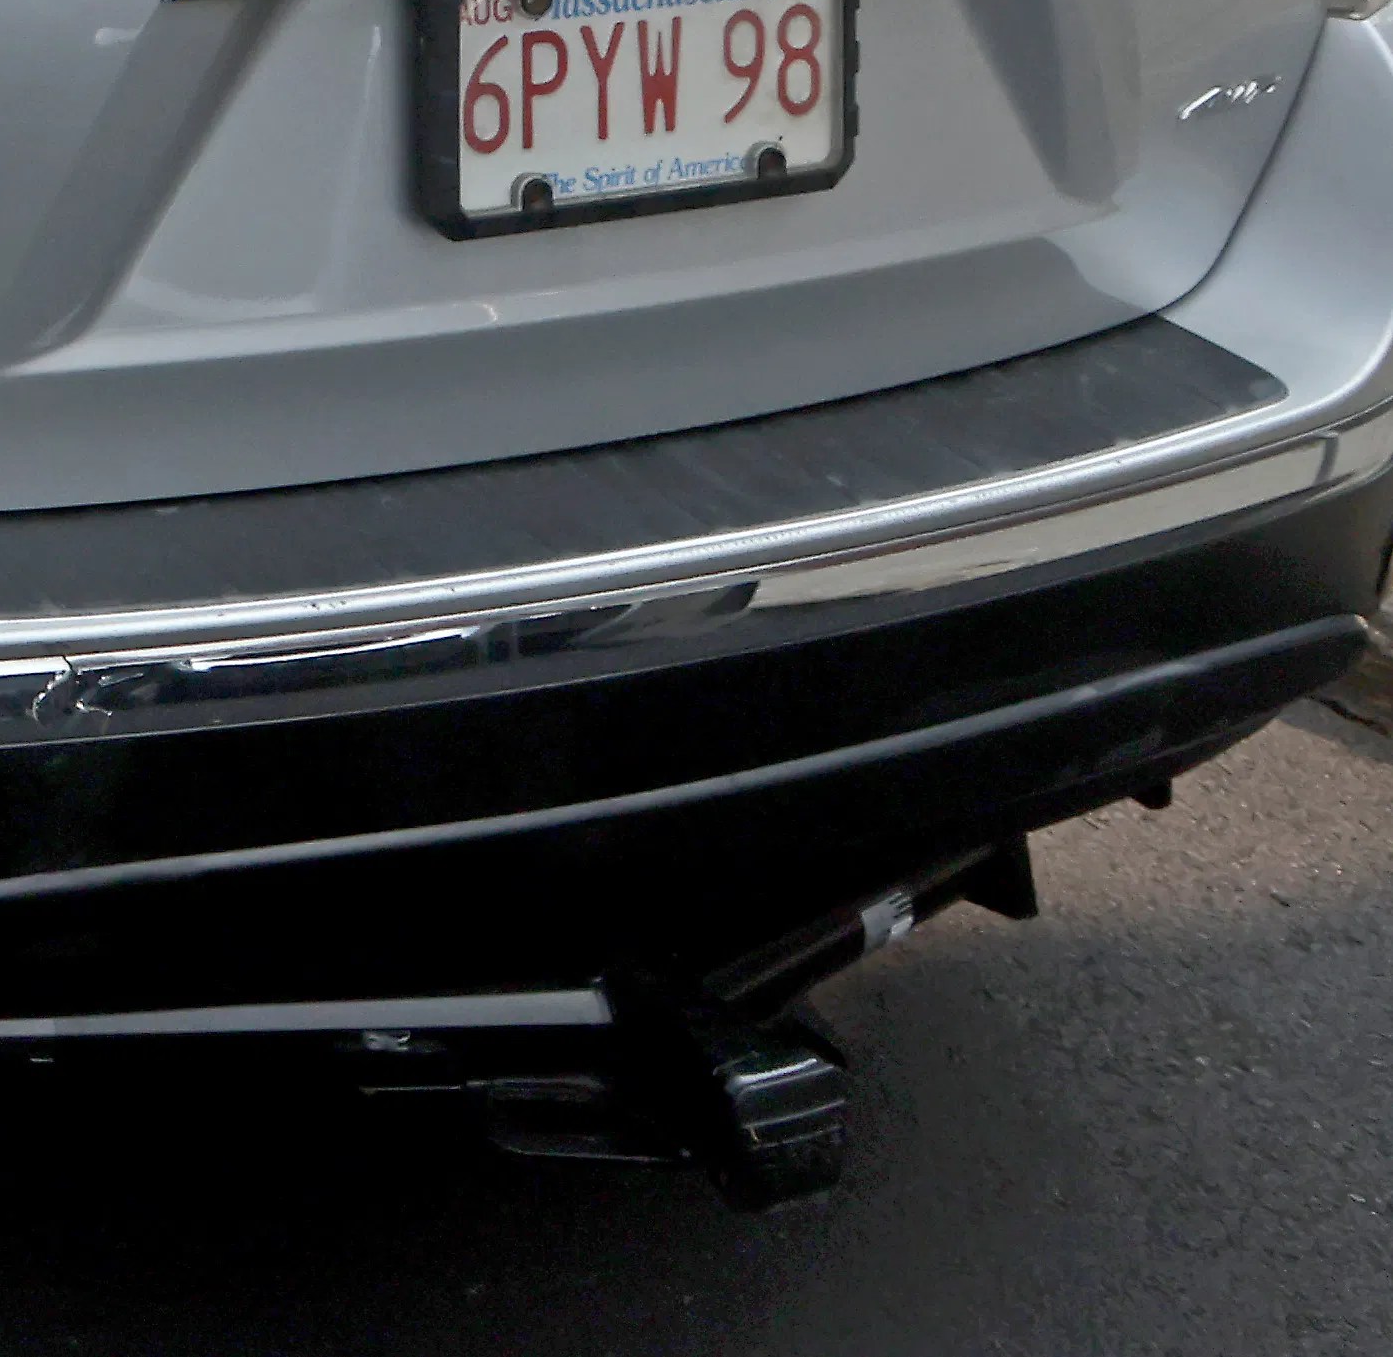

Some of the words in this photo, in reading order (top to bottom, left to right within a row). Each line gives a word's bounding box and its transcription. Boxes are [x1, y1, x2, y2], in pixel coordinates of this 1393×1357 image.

[463, 15, 682, 154] 6PYW
[723, 3, 822, 125] 98
[584, 165, 637, 193] Spirit
[644, 160, 664, 187] of
